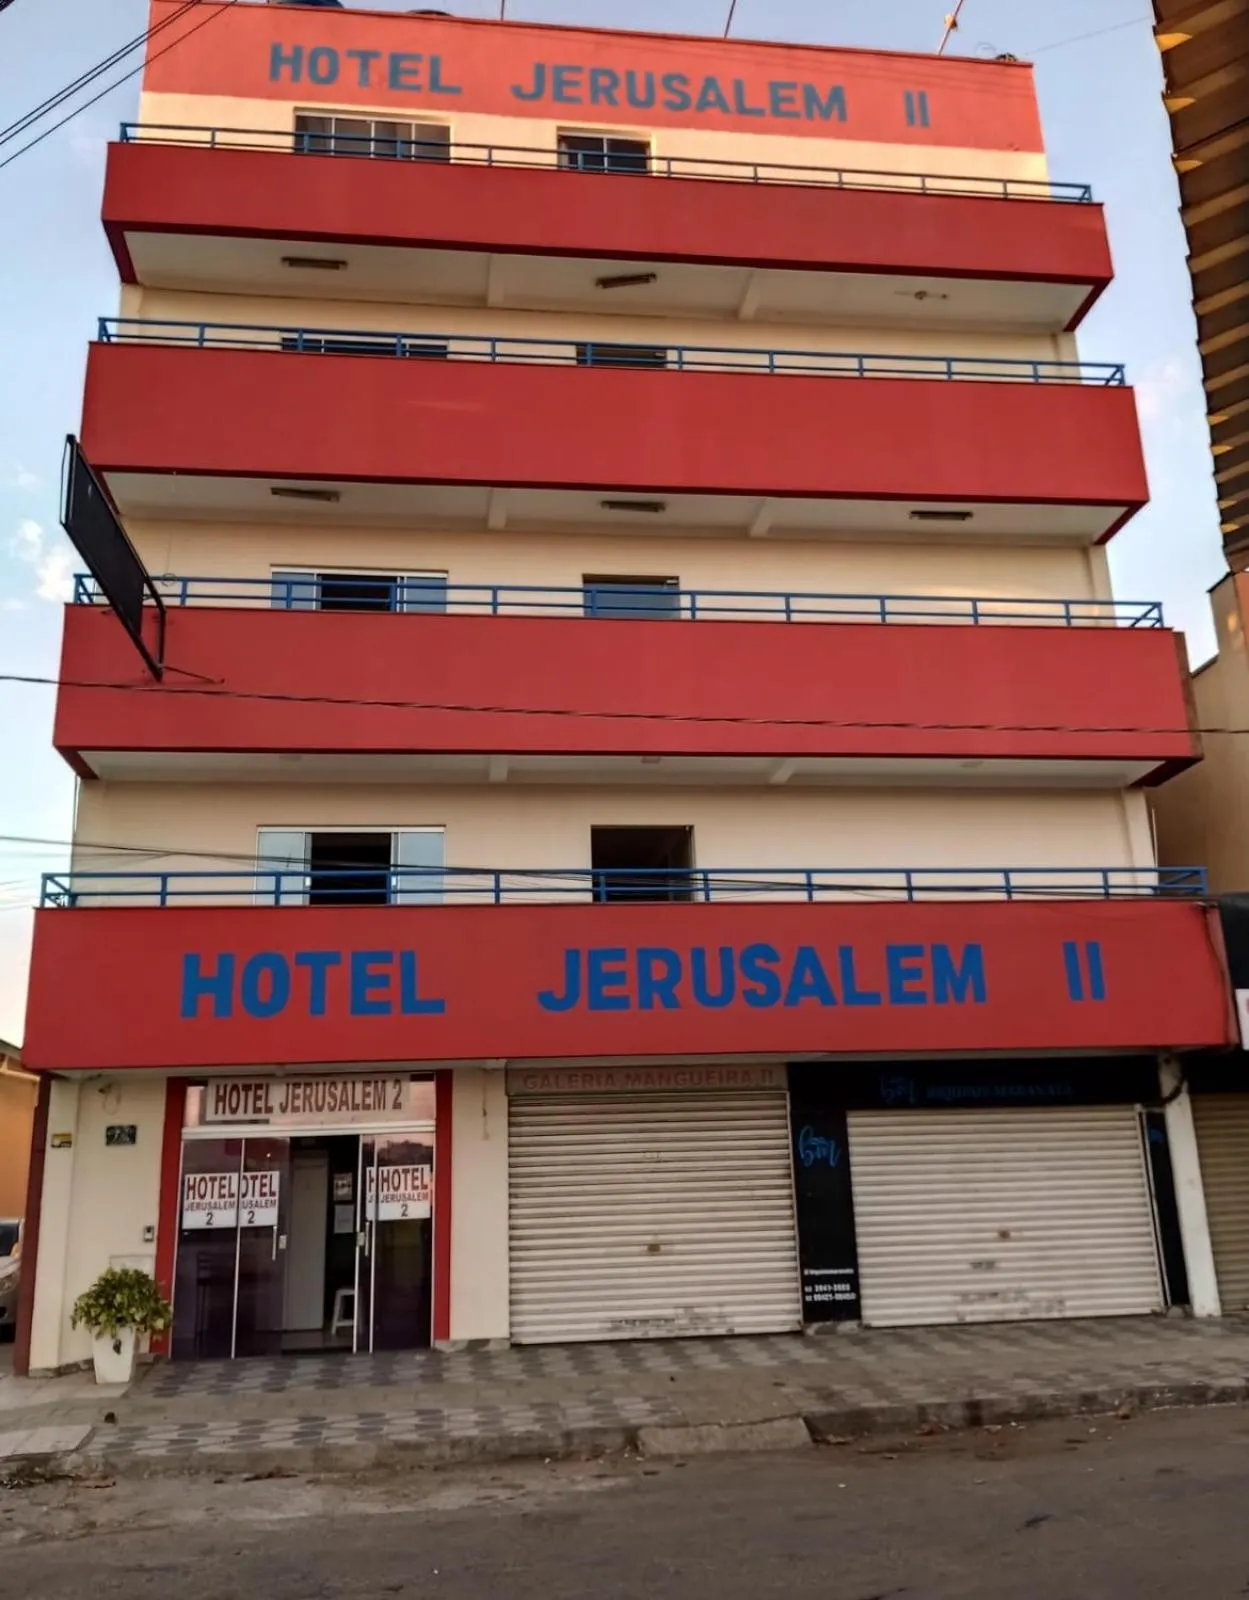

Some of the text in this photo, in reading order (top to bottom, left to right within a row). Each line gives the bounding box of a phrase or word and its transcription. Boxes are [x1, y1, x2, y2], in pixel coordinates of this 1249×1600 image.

[269, 43, 930, 127] HOTEL JERUSALEM II
[181, 941, 1105, 1019] HOTEL JERUSALEM II
[523, 1072, 616, 1090] GALERIA
[624, 1069, 750, 1088] MANGUEIRA
[214, 1079, 403, 1115] HOTEL JERUSALEM 2
[186, 1175, 236, 1200] HOTEL
[381, 1167, 429, 1193] HOTEL
[185, 1201, 236, 1211] JERUSALEM
[381, 1191, 429, 1204] JERUSALEM
[205, 1211, 214, 1226] 2
[247, 1210, 256, 1225] 2
[400, 1203, 409, 1217] 2
